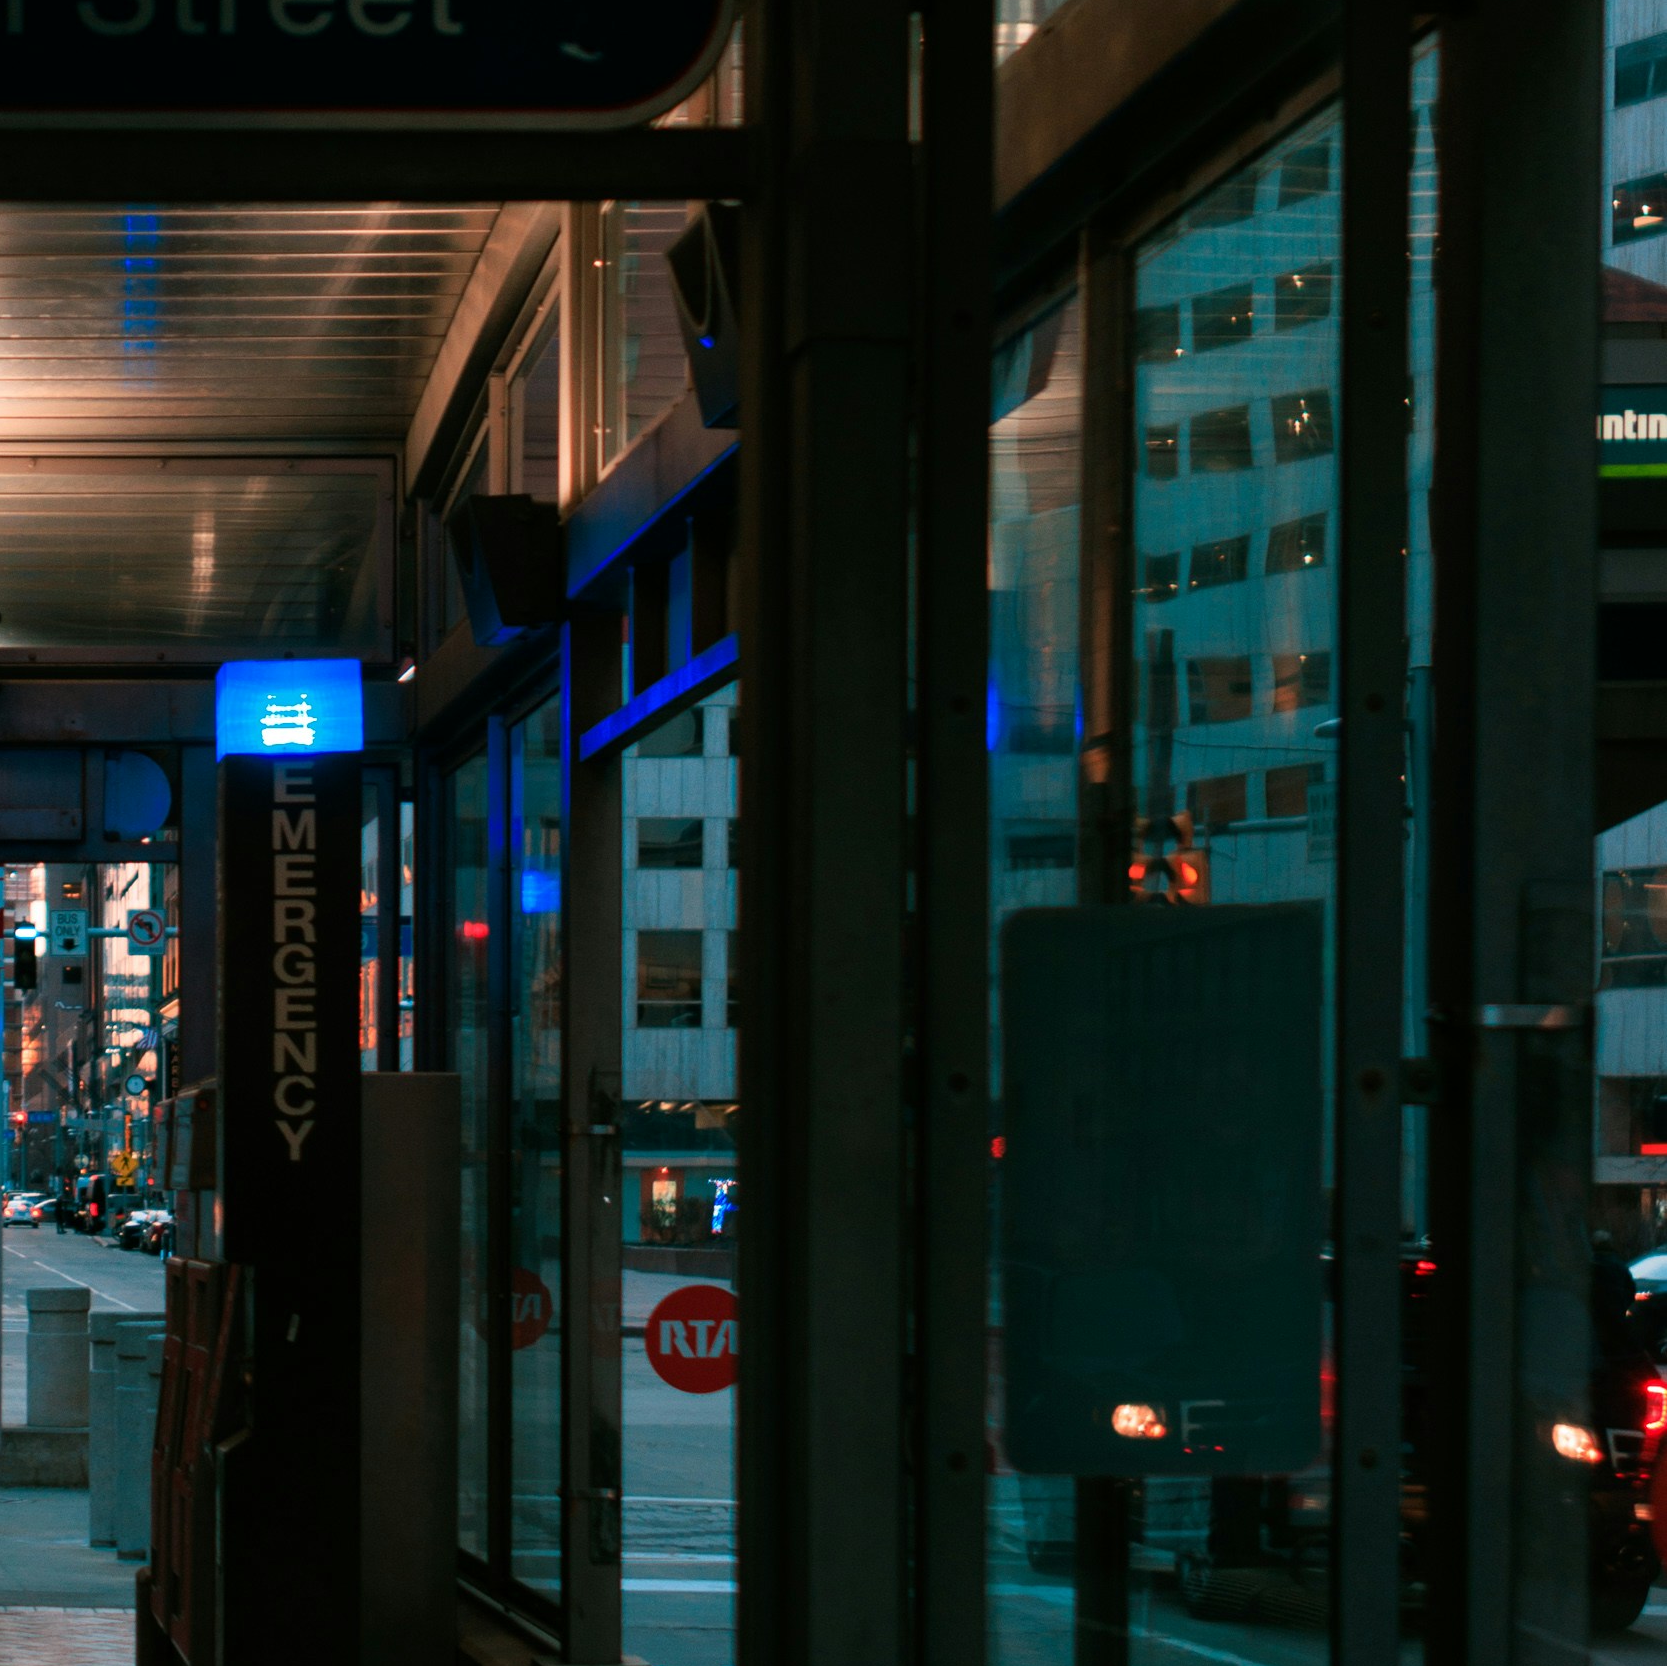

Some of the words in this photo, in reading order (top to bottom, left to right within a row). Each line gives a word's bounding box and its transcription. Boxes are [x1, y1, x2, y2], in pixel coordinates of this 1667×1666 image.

[55, 925, 80, 936] ONLY
[58, 914, 78, 924] BUS
[272, 761, 317, 1162] EMERGENCY
[658, 1319, 737, 1359] RTA
